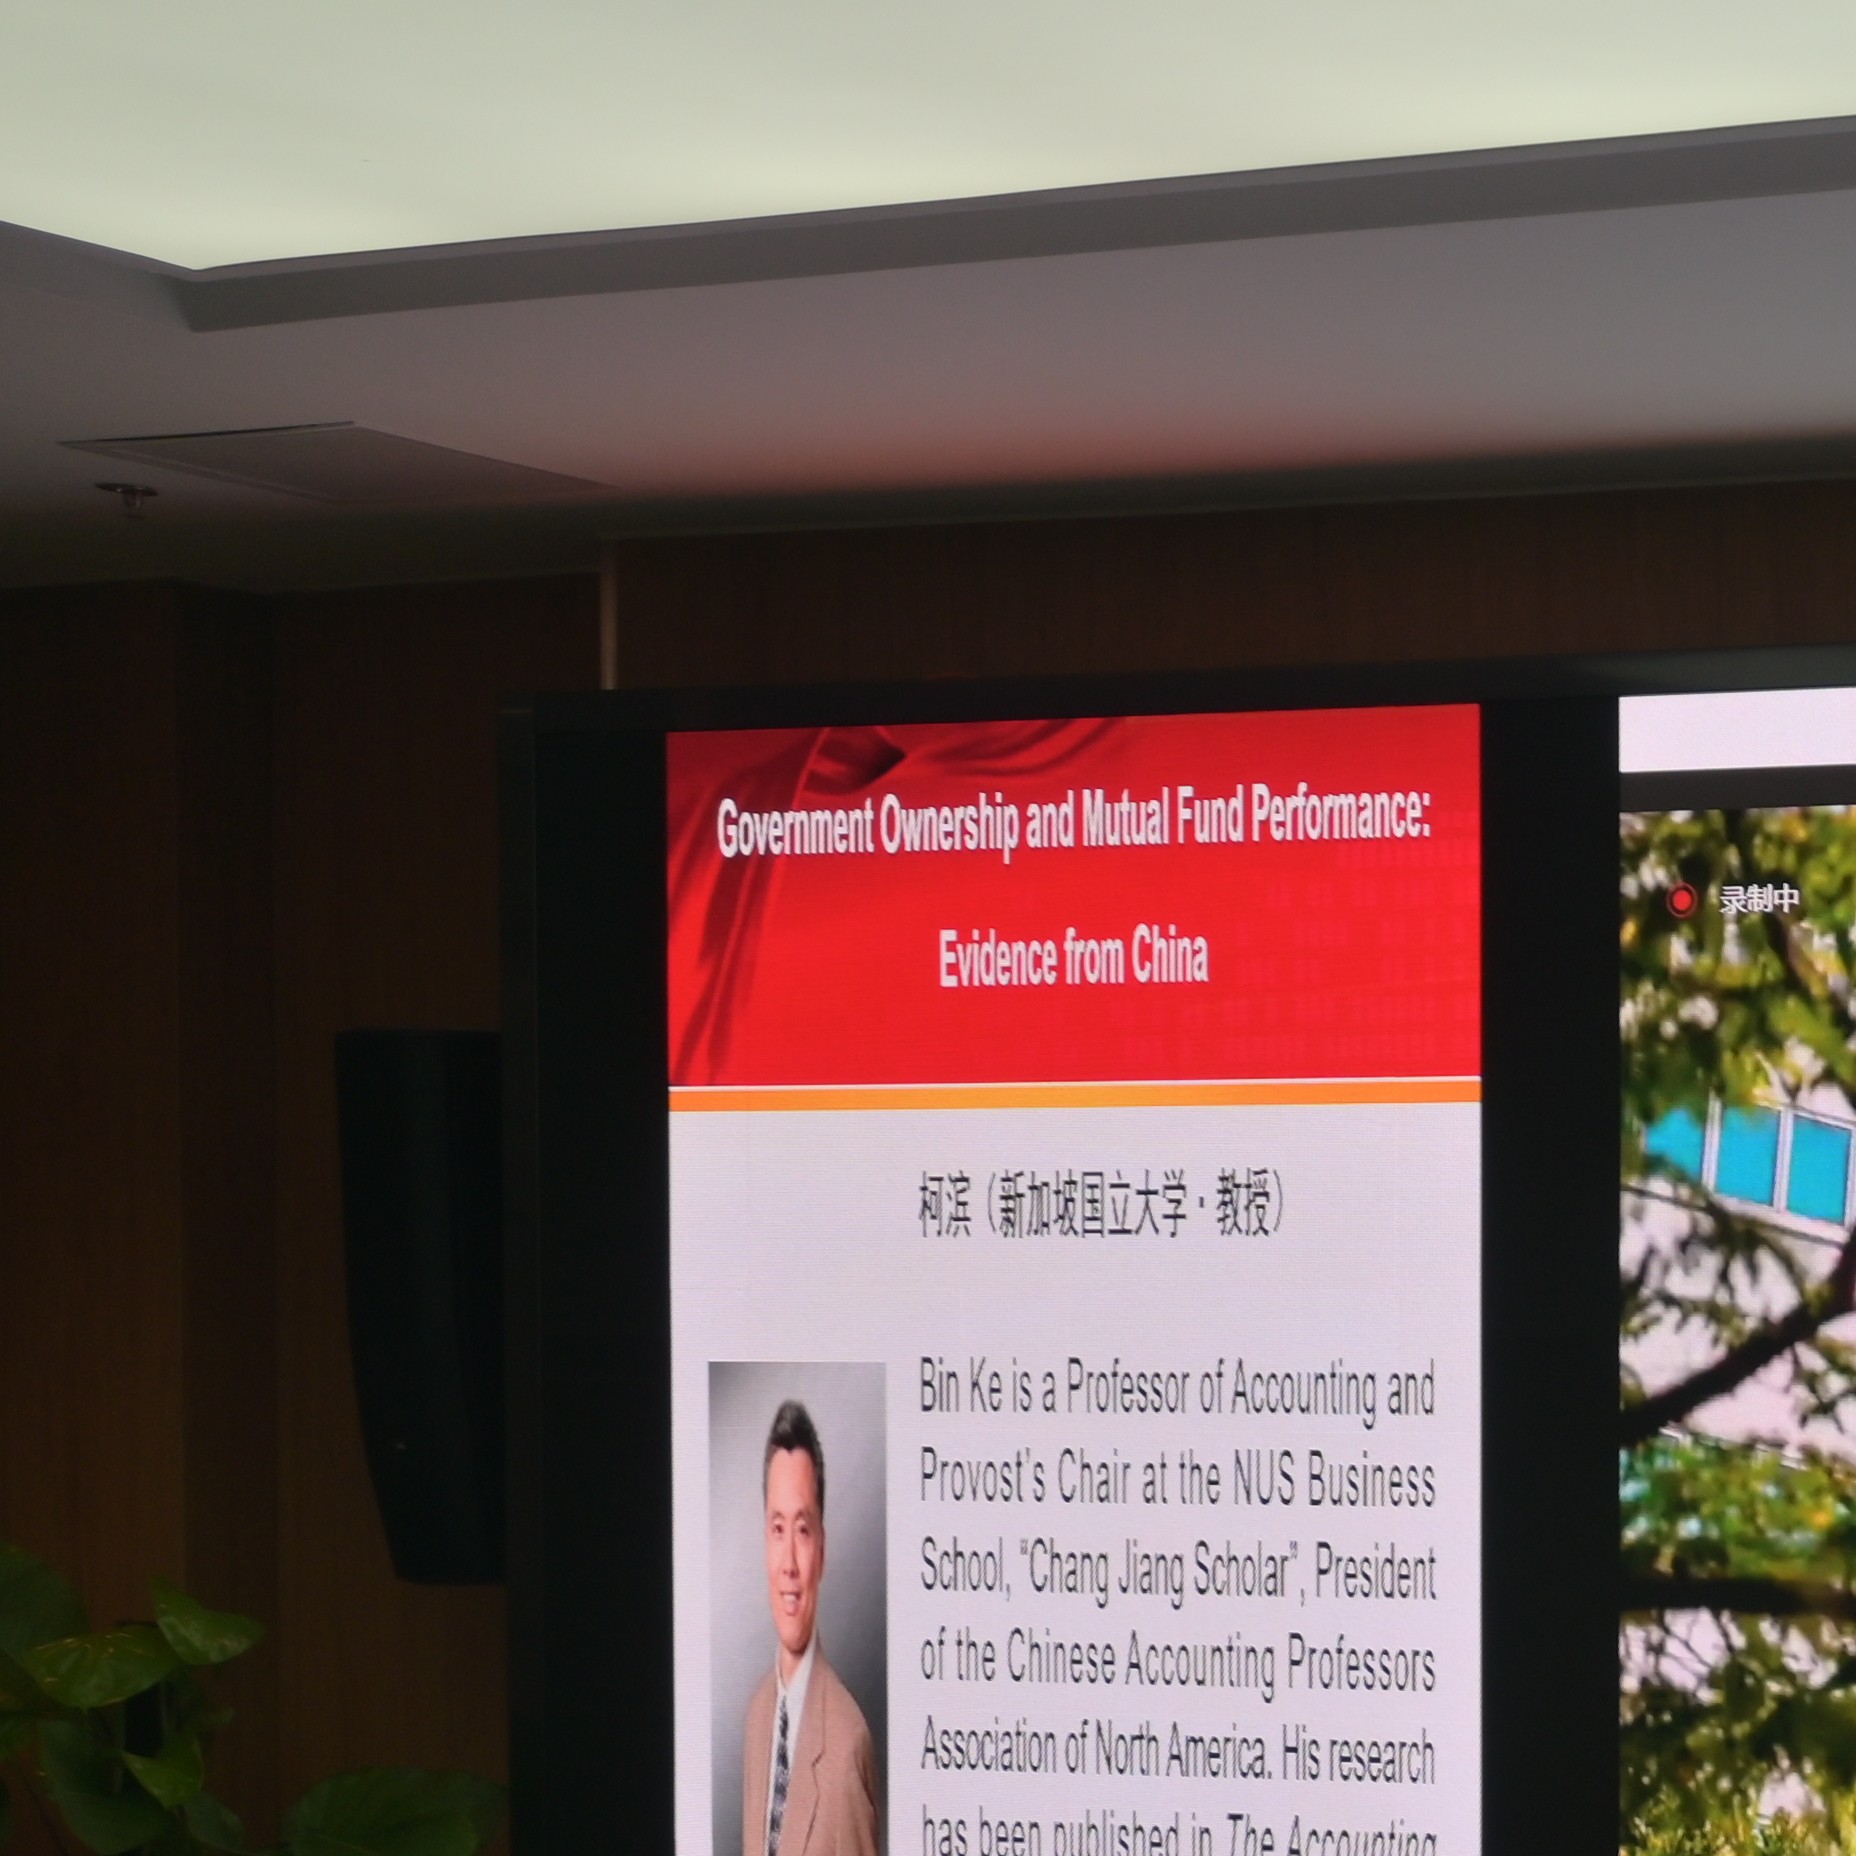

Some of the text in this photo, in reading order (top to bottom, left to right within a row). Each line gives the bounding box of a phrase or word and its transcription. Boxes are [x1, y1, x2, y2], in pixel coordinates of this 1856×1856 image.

[717, 781, 1432, 864] Government Ownership and Mutual Fund Performance:
[1719, 884, 1799, 916] 录制中
[938, 923, 1209, 988] Evidence from China
[920, 1357, 1435, 1431] Bin Ke is a Professor of Accounting and
[1058, 1448, 1131, 1503] Chair
[1142, 1449, 1167, 1504] at
[1179, 1449, 1220, 1504] the
[1234, 1448, 1295, 1506] NUS
[1308, 1449, 1436, 1508] Business
[921, 1536, 1011, 1602] School,
[1118, 1538, 1185, 1610] Jiang
[1316, 1541, 1437, 1601] President
[921, 1626, 1436, 1703] of the Chinese Accounting Professors
[921, 1715, 1435, 1784] Association of North America. His research
